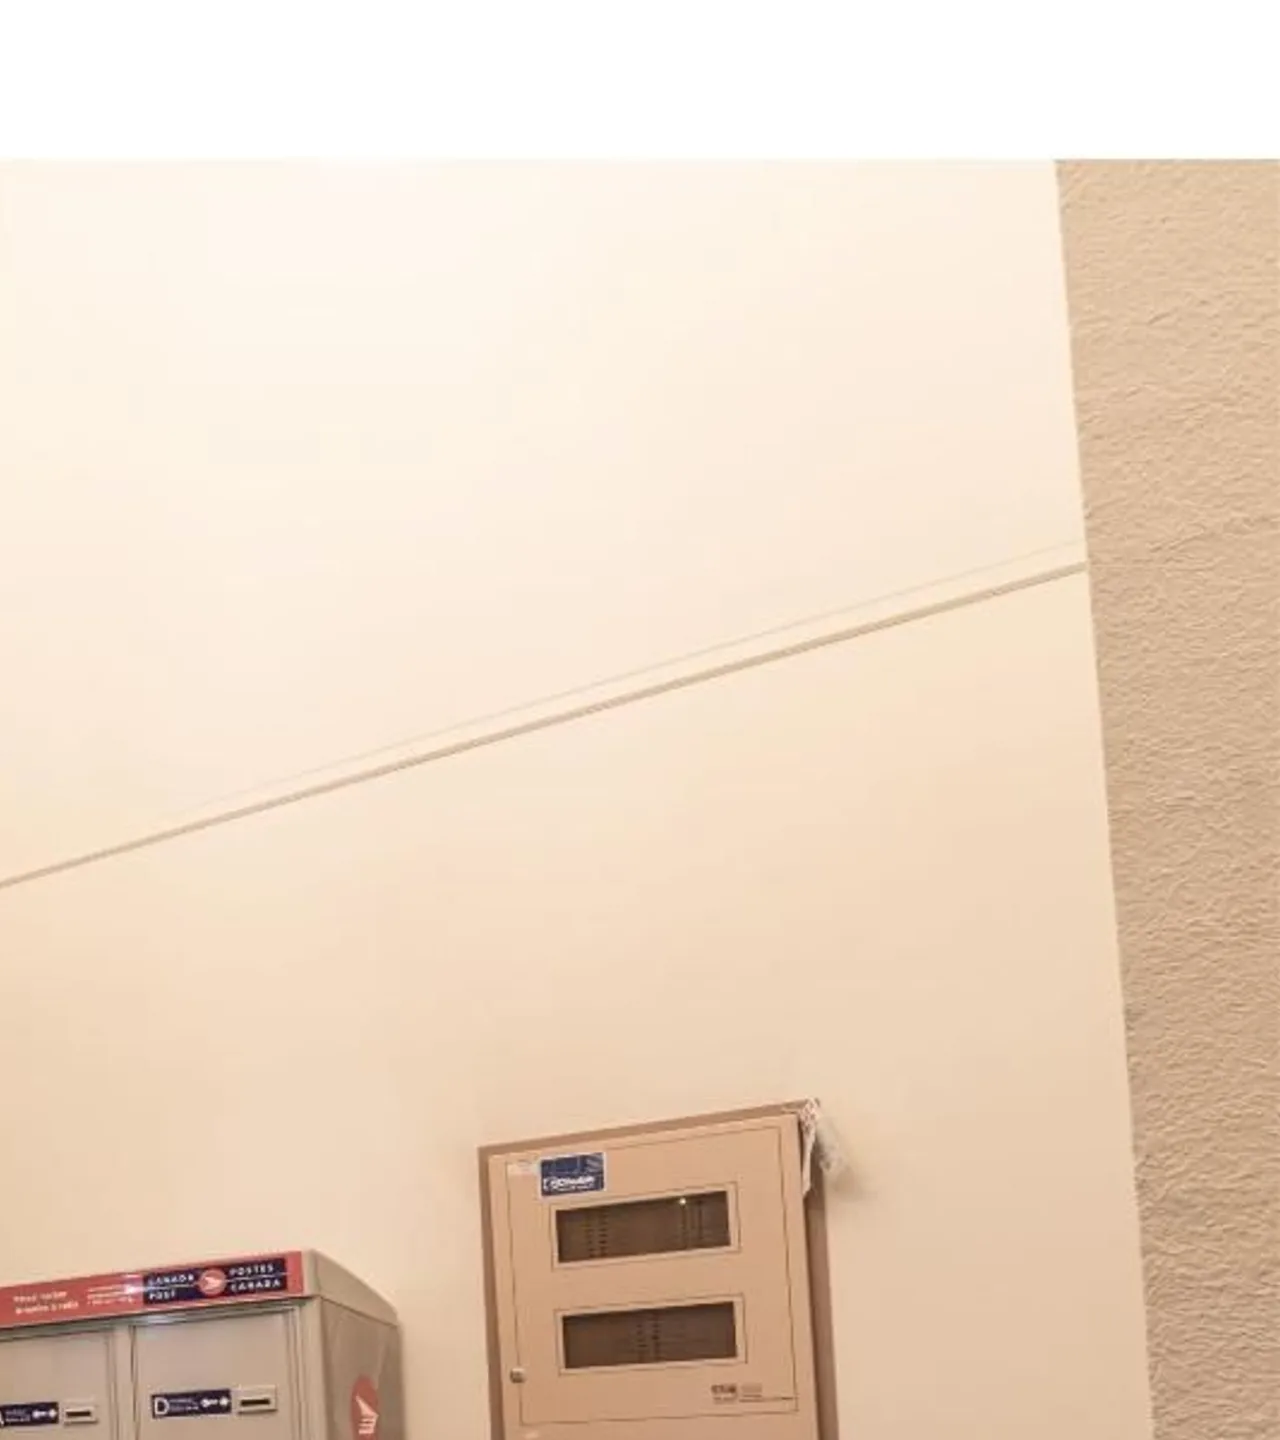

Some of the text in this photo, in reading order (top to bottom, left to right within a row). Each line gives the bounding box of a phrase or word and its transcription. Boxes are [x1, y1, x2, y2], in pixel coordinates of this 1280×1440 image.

[229, 1263, 274, 1277] POSTES
[230, 1279, 282, 1293] CANADA
[149, 1290, 176, 1301] POST
[154, 1396, 170, 1415] D
